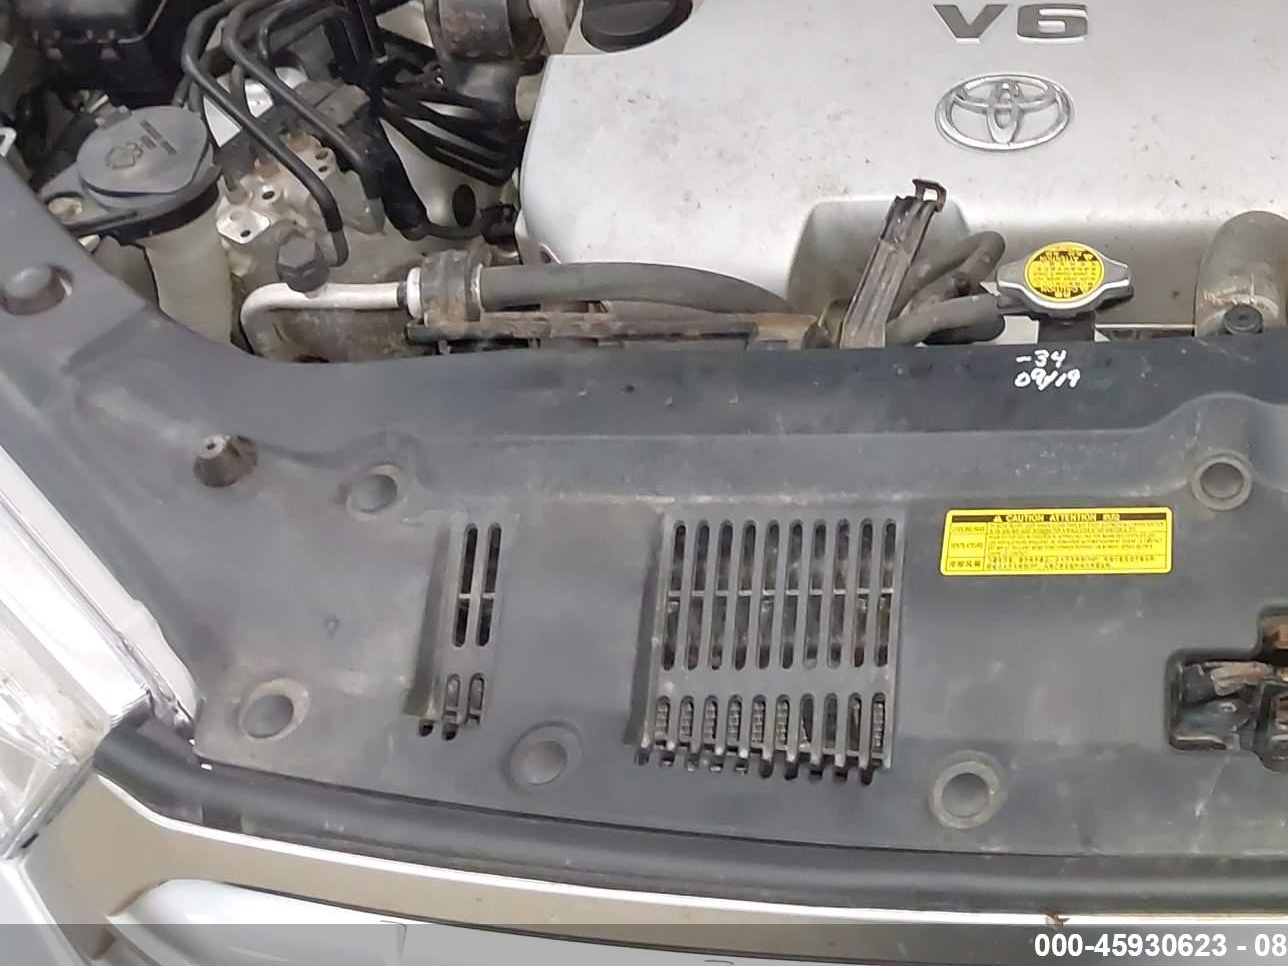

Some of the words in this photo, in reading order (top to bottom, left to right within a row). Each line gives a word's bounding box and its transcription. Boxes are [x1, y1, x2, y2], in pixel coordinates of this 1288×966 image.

[932, 2, 1089, 43] V6
[1005, 513, 1044, 523] CAUTION
[1049, 513, 1097, 522] ATTENTION
